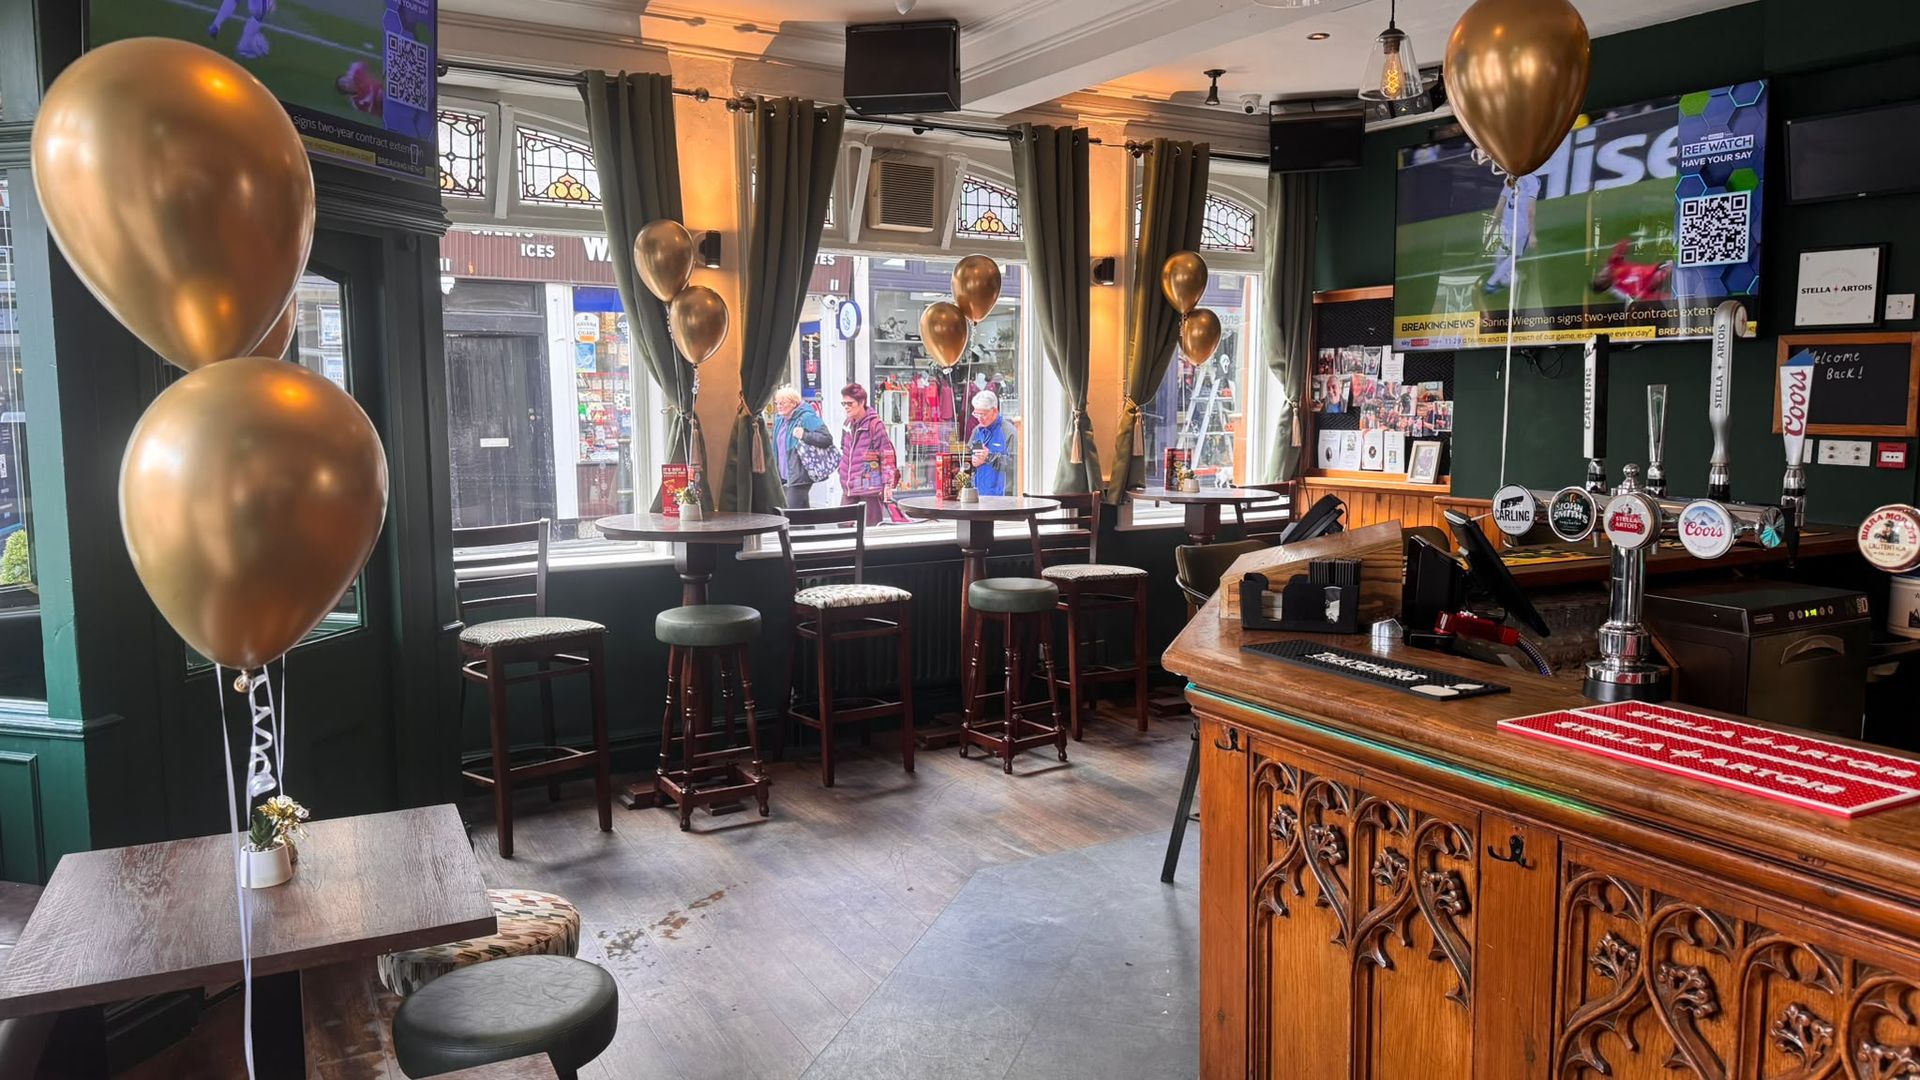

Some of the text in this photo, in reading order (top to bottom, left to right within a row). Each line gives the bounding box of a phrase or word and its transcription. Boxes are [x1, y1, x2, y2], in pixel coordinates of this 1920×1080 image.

[293, 115, 317, 130] signs
[318, 120, 355, 139] two-year
[355, 132, 388, 149] contract
[1683, 143, 1706, 156] REF
[1708, 136, 1753, 152] WATCH
[1681, 151, 1753, 168] HAVE YOUR SAY
[520, 243, 556, 258] ICES
[1801, 284, 1873, 295] STELLA ARTOIS
[1511, 315, 1555, 327] Wiegman
[1557, 313, 1583, 326] signs
[1584, 309, 1629, 324] two-year
[1631, 308, 1679, 320] contract
[1680, 306, 1719, 317] extens
[1401, 319, 1475, 332] BREAKING NEWS
[1658, 327, 1702, 335] BREAKING
[1714, 323, 1727, 409] STELLA ARTOIS
[1584, 368, 1592, 430] CARLING
[1783, 369, 1808, 437] Coors
[1495, 508, 1530, 522] CARLING
[1557, 502, 1584, 513] JOHN
[1553, 510, 1589, 524] SMITH'S
[1615, 516, 1639, 524] STELLA
[1615, 522, 1638, 530] ARTOIS
[1684, 521, 1724, 537] Coors
[1626, 710, 1917, 779] STELLA ARTOIS
[1554, 721, 1847, 795] STELLA ARTOIS
